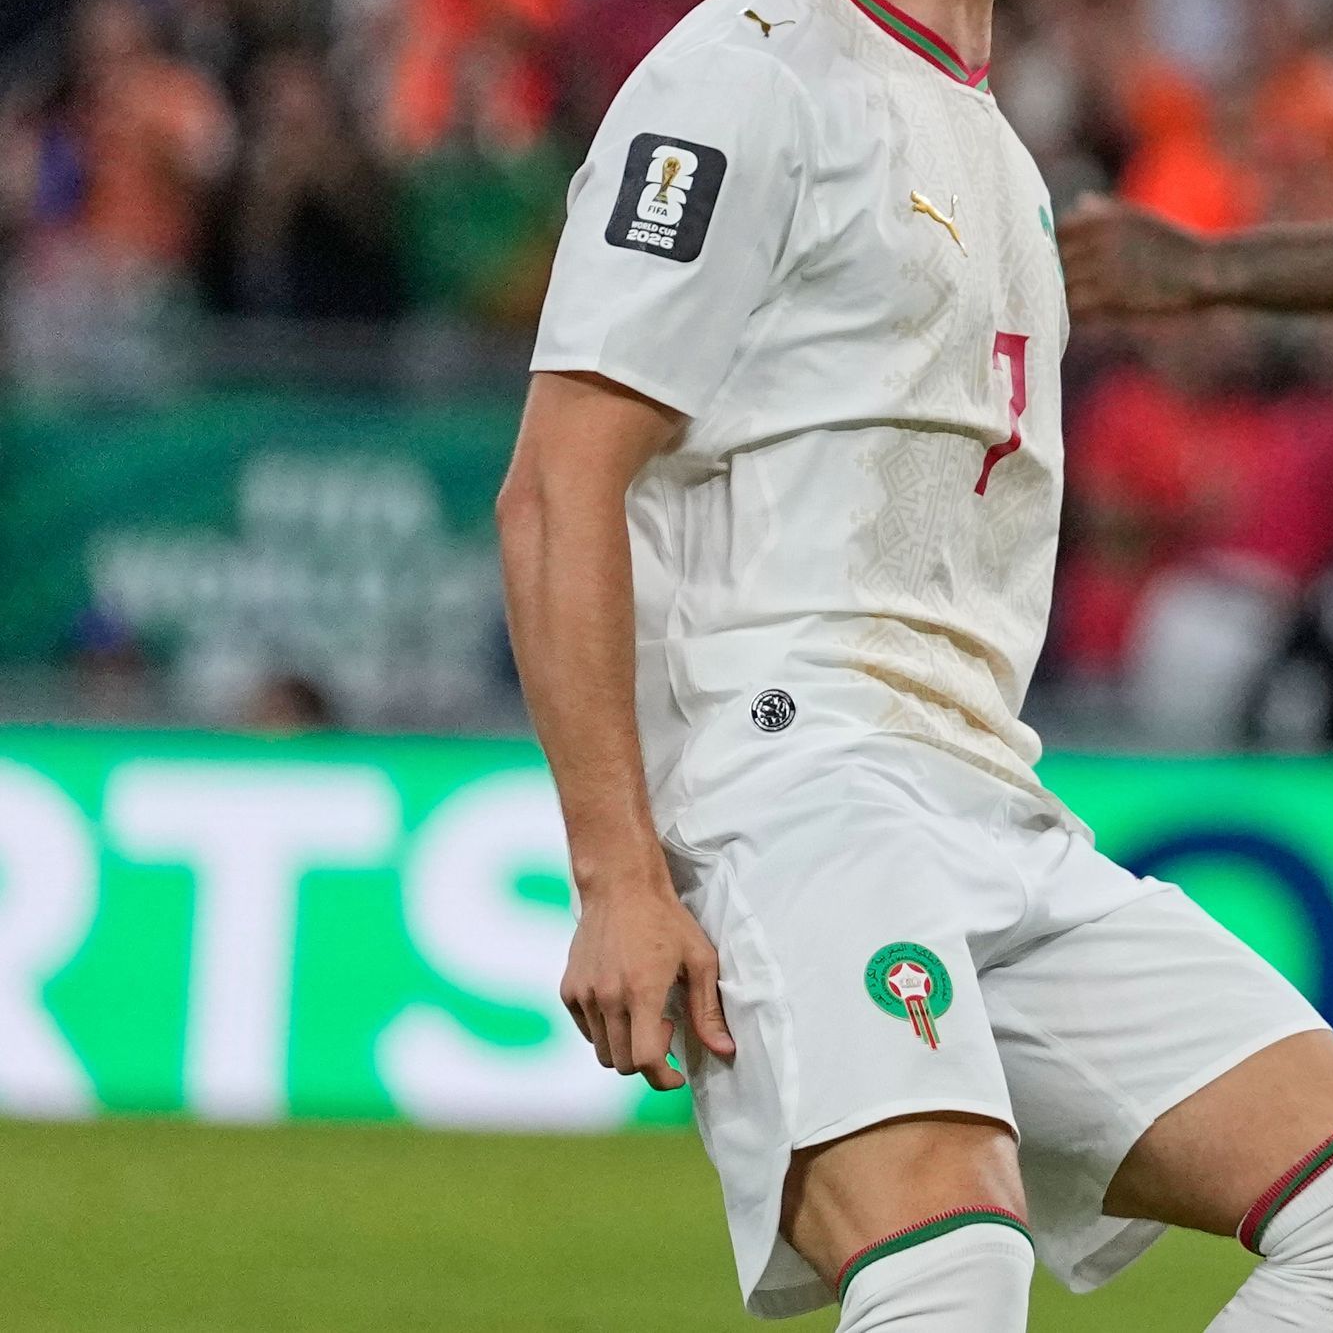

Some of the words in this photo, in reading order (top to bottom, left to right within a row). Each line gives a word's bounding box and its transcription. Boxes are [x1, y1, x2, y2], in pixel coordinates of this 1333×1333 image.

[647, 205, 669, 217] FIFA
[631, 220, 659, 233] WORLD
[659, 226, 677, 237] CUP
[626, 229, 675, 250] 2026
[974, 330, 1030, 497] 7
